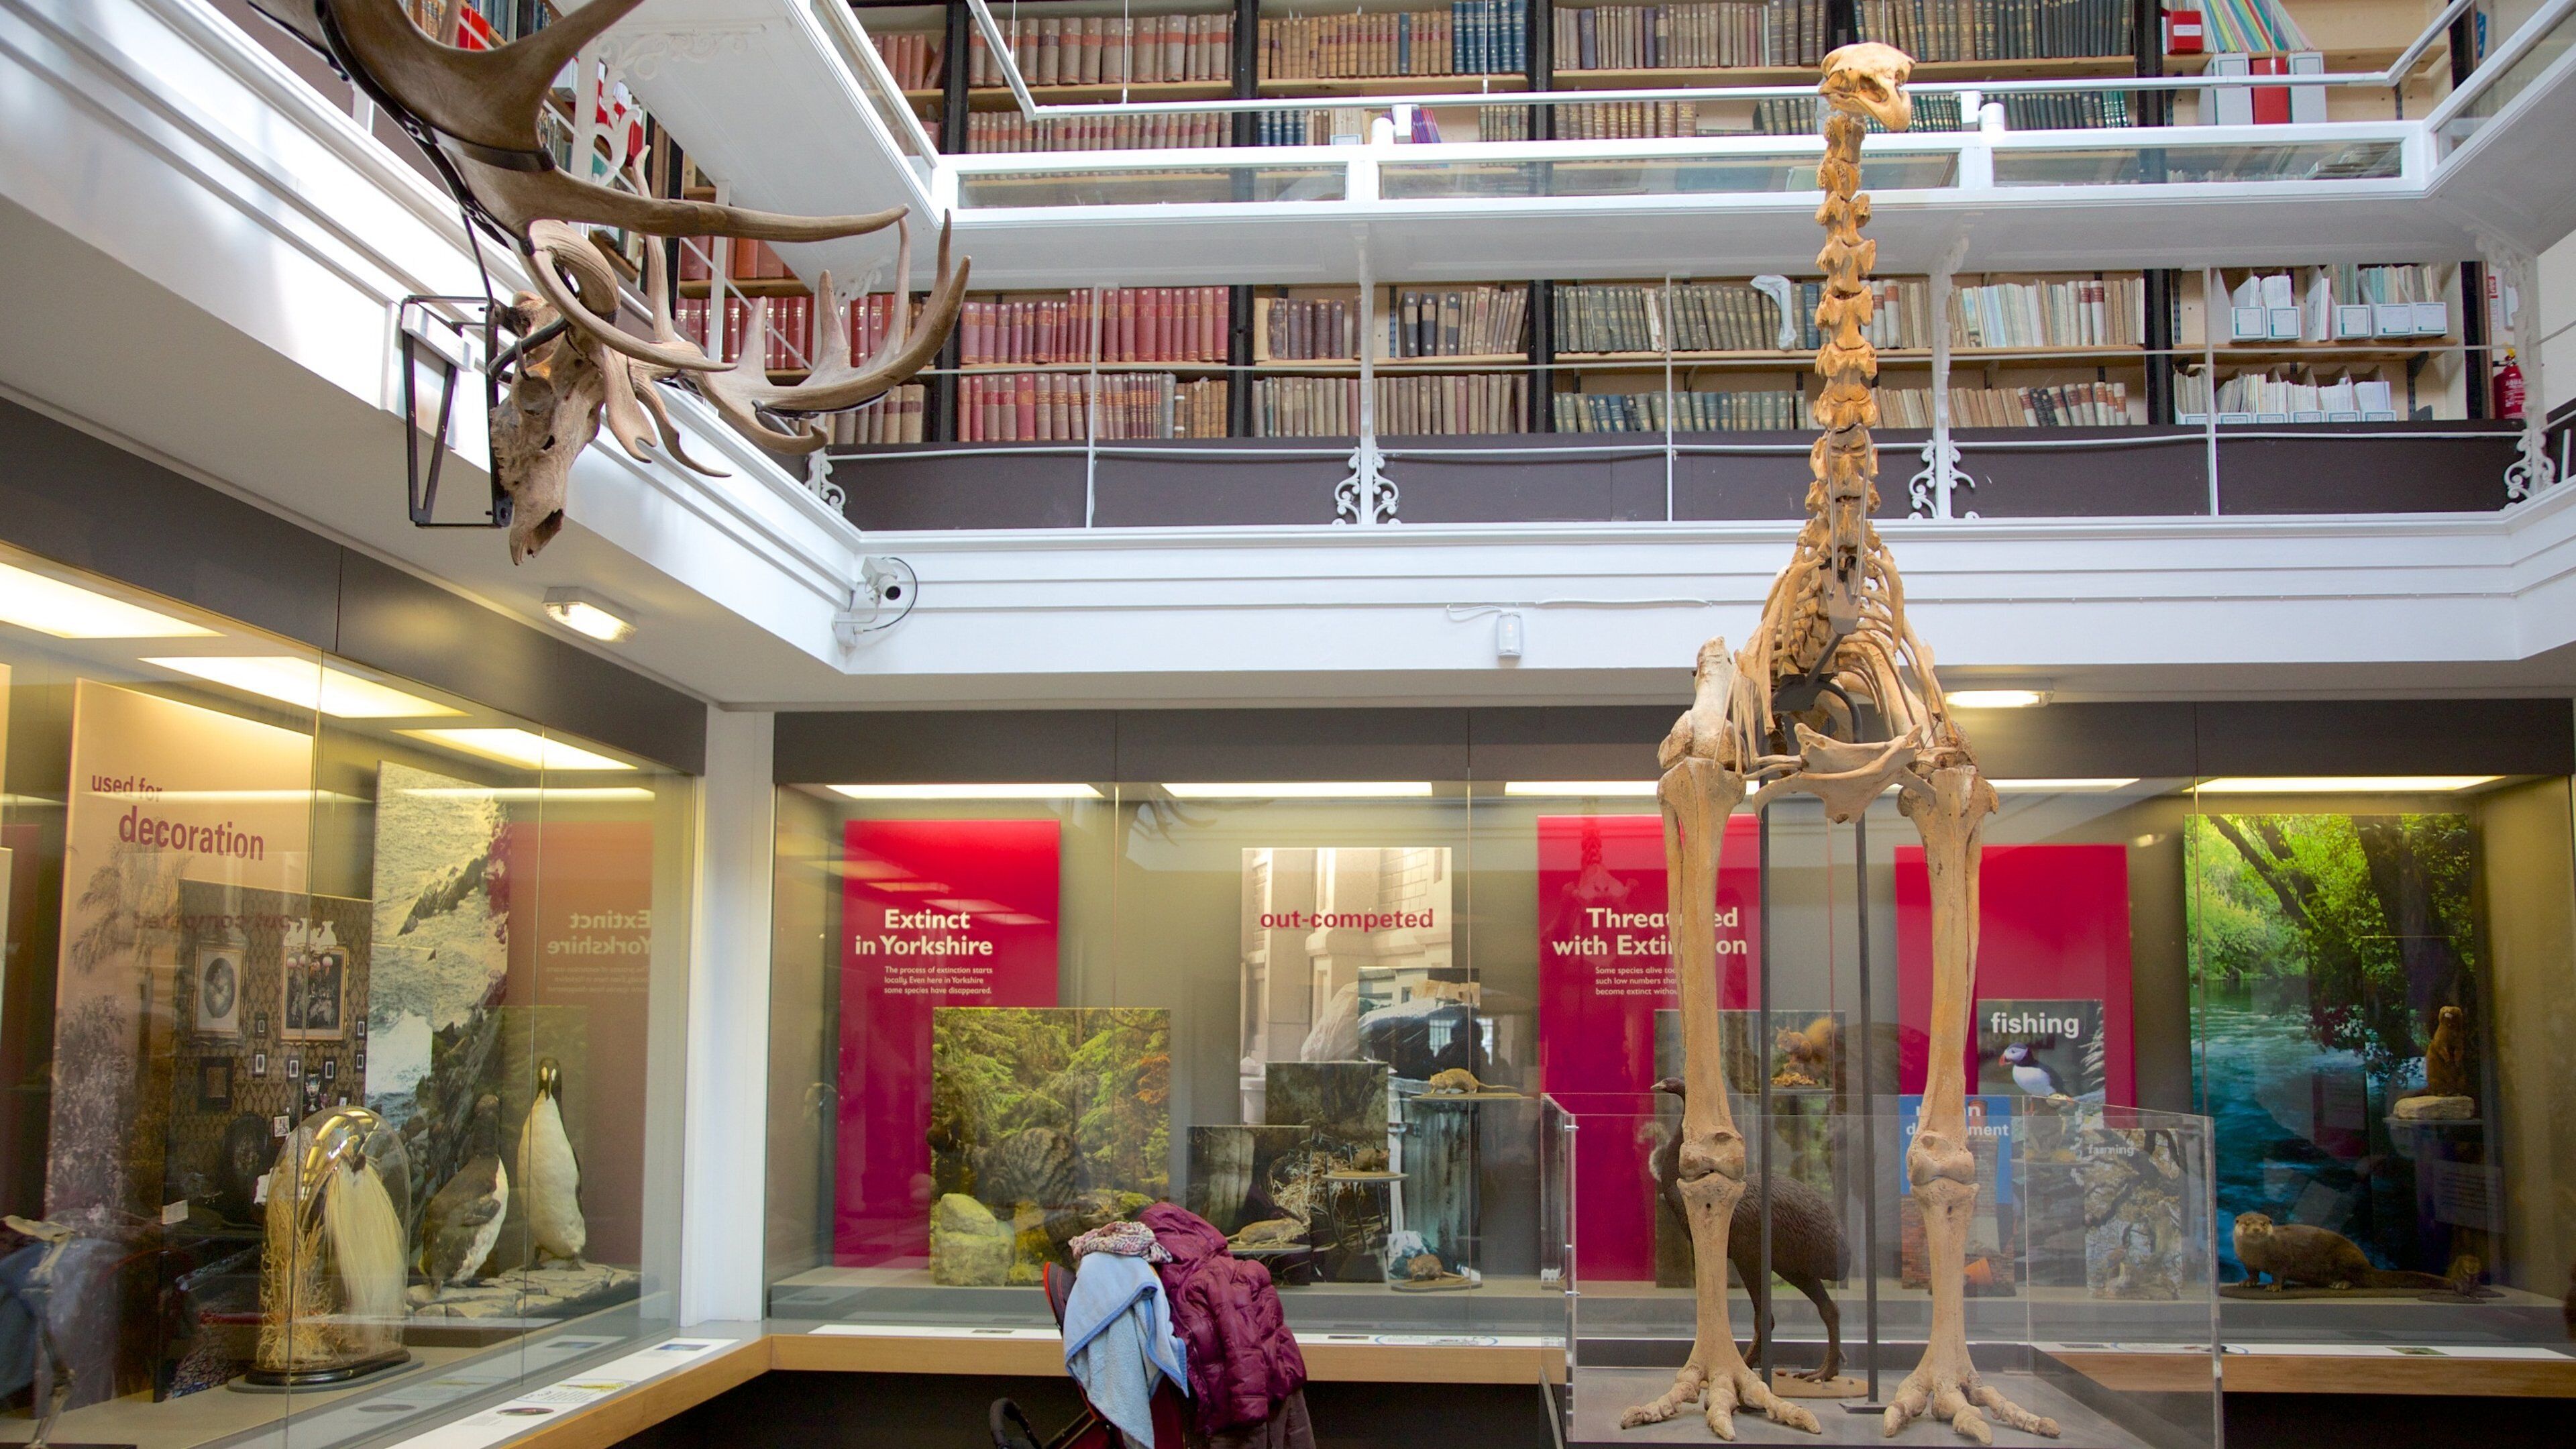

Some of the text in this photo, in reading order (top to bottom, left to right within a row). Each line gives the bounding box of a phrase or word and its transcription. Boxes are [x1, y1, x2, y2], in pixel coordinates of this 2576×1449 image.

[92, 774, 163, 802] used for
[119, 805, 264, 861] decoration
[884, 909, 971, 929] Extinct
[1260, 908, 1435, 933] out-competed
[1586, 907, 1738, 928] Threaed
[855, 934, 994, 955] in Yorkshire
[1552, 934, 1748, 955] with Extion
[1595, 977, 1612, 985] such
[1614, 977, 1628, 985] low
[1629, 977, 1661, 985] numbers
[1617, 967, 1644, 976] species
[1646, 966, 1662, 974] alive
[904, 987, 929, 996] species
[949, 987, 992, 996] disappeared.
[1990, 1012, 2080, 1039] fishing
